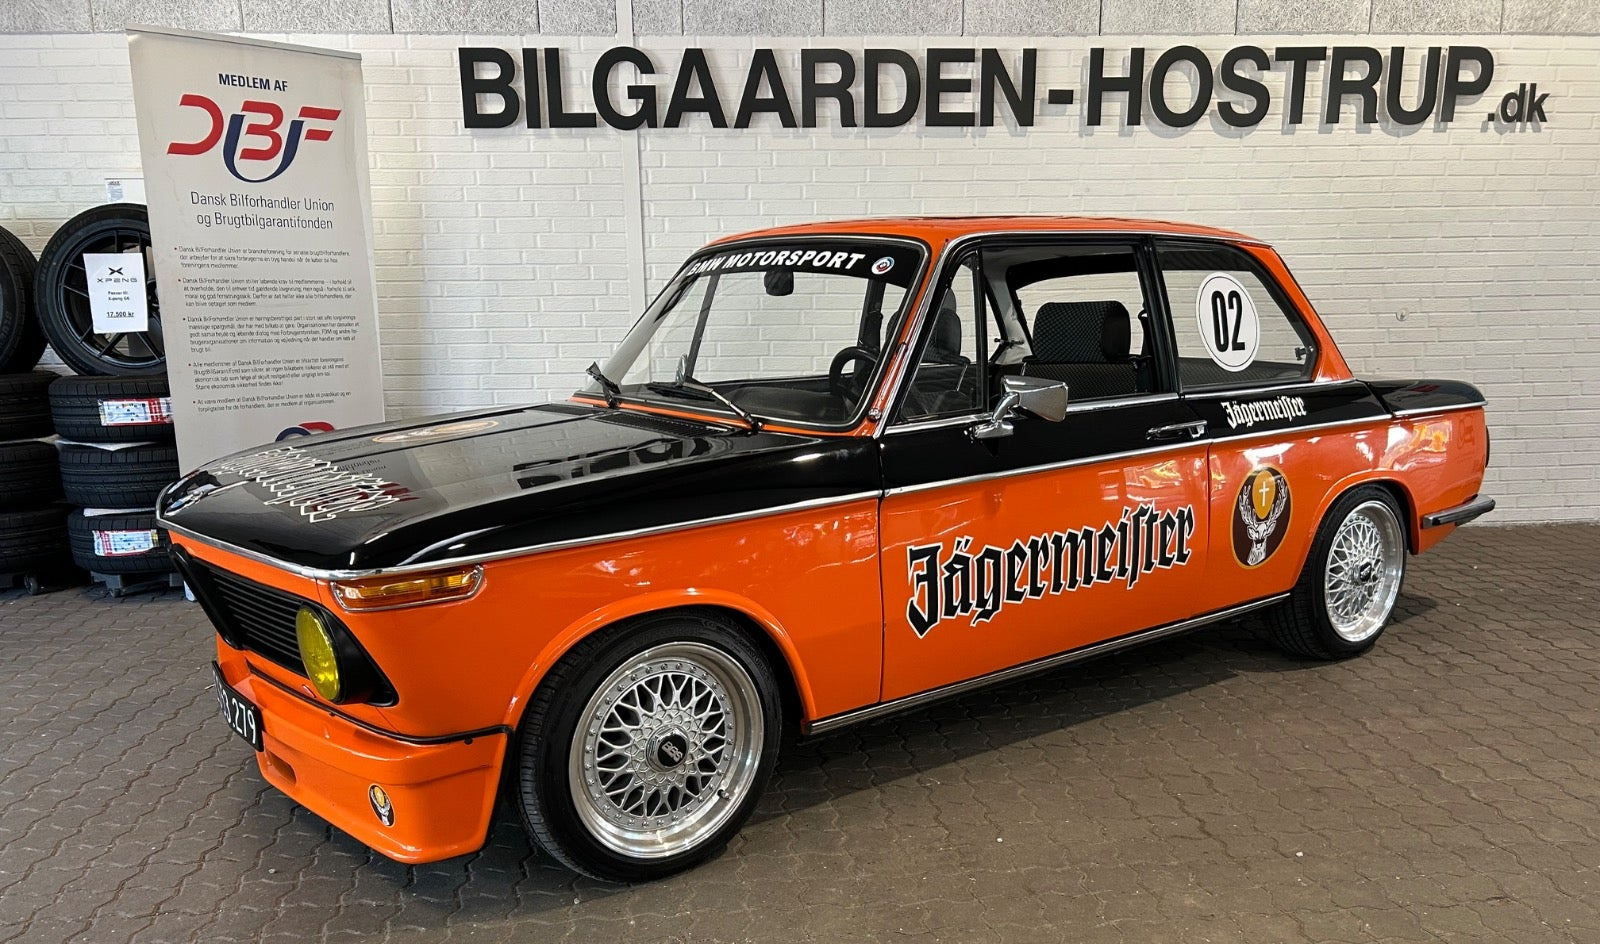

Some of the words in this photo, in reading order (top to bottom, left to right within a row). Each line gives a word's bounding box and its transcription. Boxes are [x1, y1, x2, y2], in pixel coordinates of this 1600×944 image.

[219, 73, 270, 90] MEDLEM
[274, 80, 288, 92] AF
[190, 191, 227, 206] Dansk
[230, 194, 300, 209] Bilforhandler
[304, 198, 335, 211] Union
[197, 214, 211, 227] og
[215, 212, 333, 229] Brugtbilgarantifonden
[687, 256, 727, 277] BMW
[722, 250, 866, 270] MOTORSPORT
[1211, 290, 1245, 353] 02
[661, 741, 683, 762] BBS
